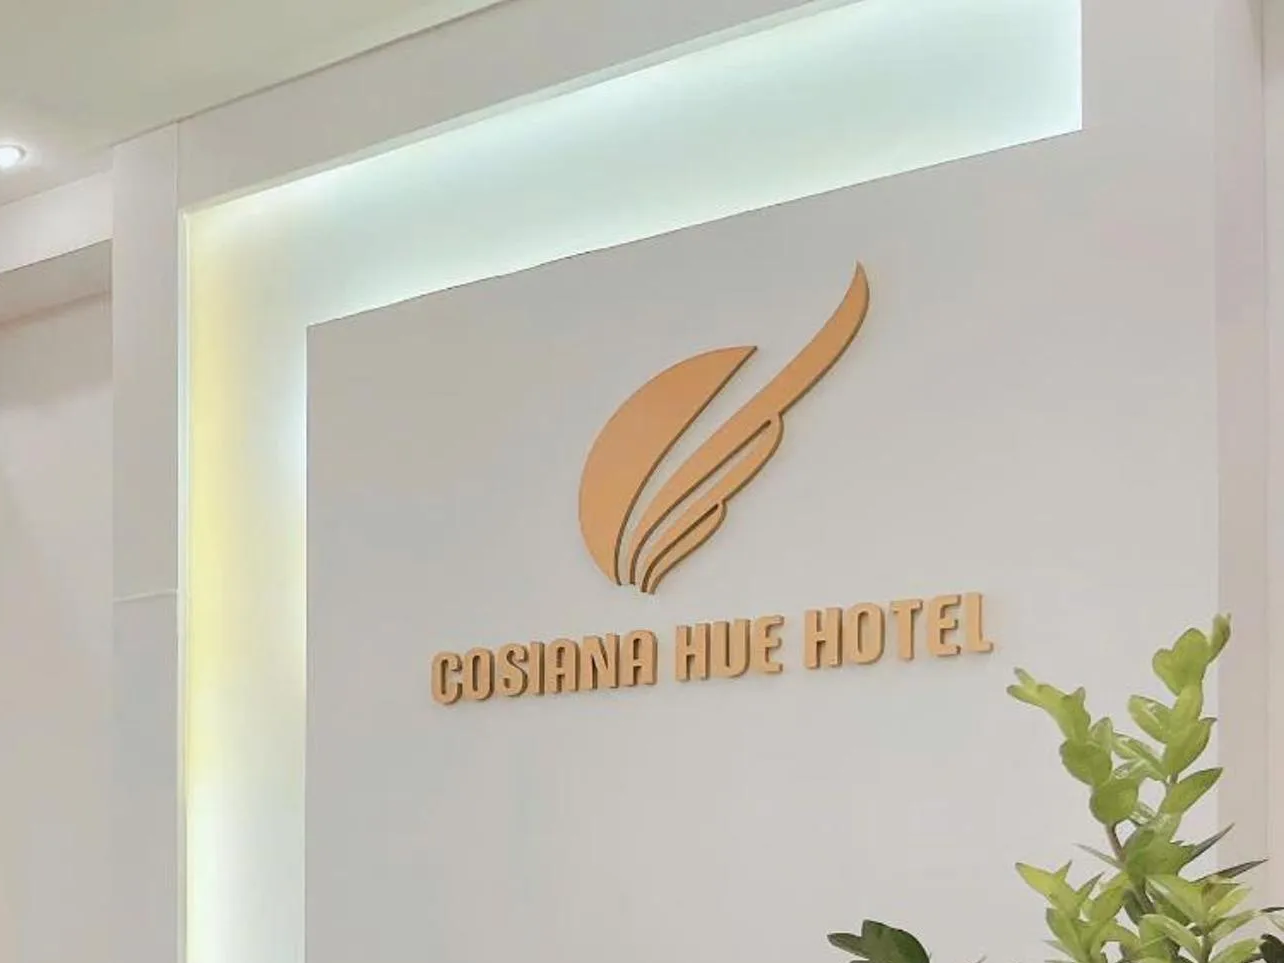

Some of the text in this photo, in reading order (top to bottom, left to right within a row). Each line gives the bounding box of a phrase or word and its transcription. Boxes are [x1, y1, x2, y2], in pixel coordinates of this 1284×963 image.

[430, 591, 994, 706] COSIANA HUE HOTEL
